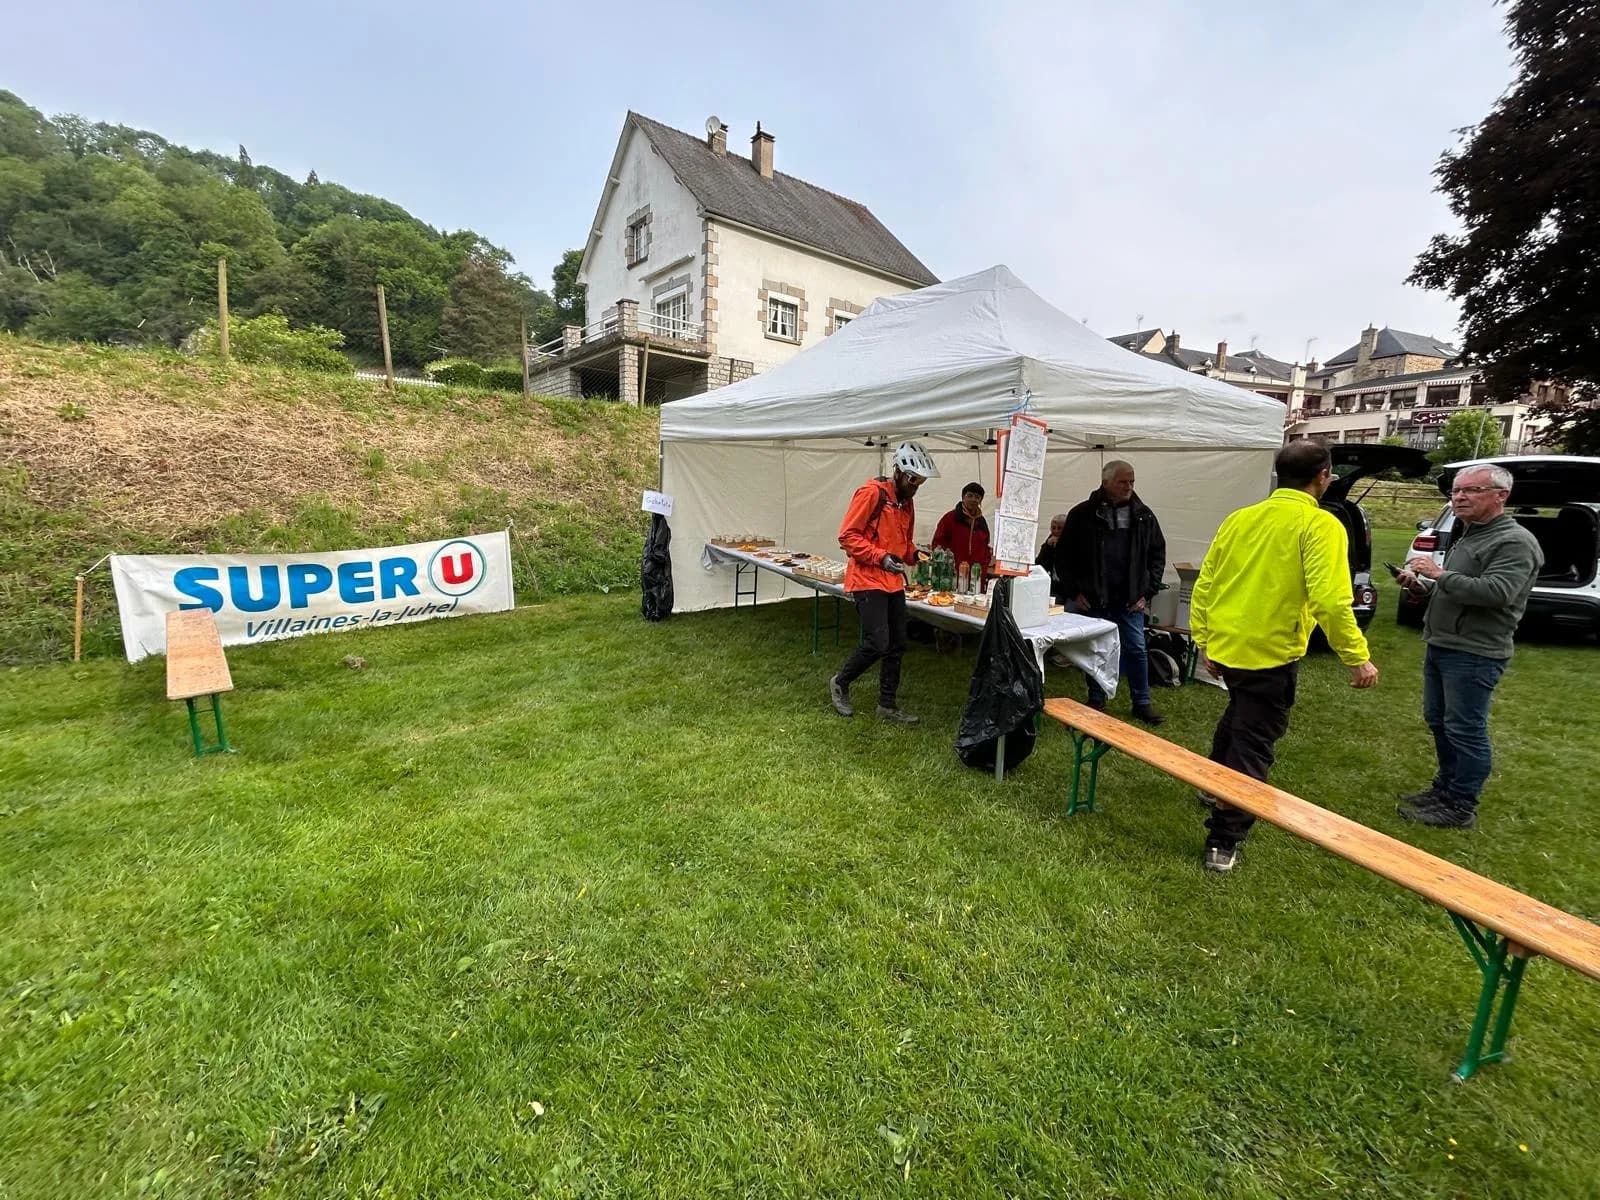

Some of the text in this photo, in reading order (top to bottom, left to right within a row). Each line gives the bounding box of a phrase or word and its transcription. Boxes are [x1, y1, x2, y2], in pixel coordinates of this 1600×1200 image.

[174, 552, 474, 613] SUPER U
[246, 597, 459, 638] Villaines-la-Juhel
